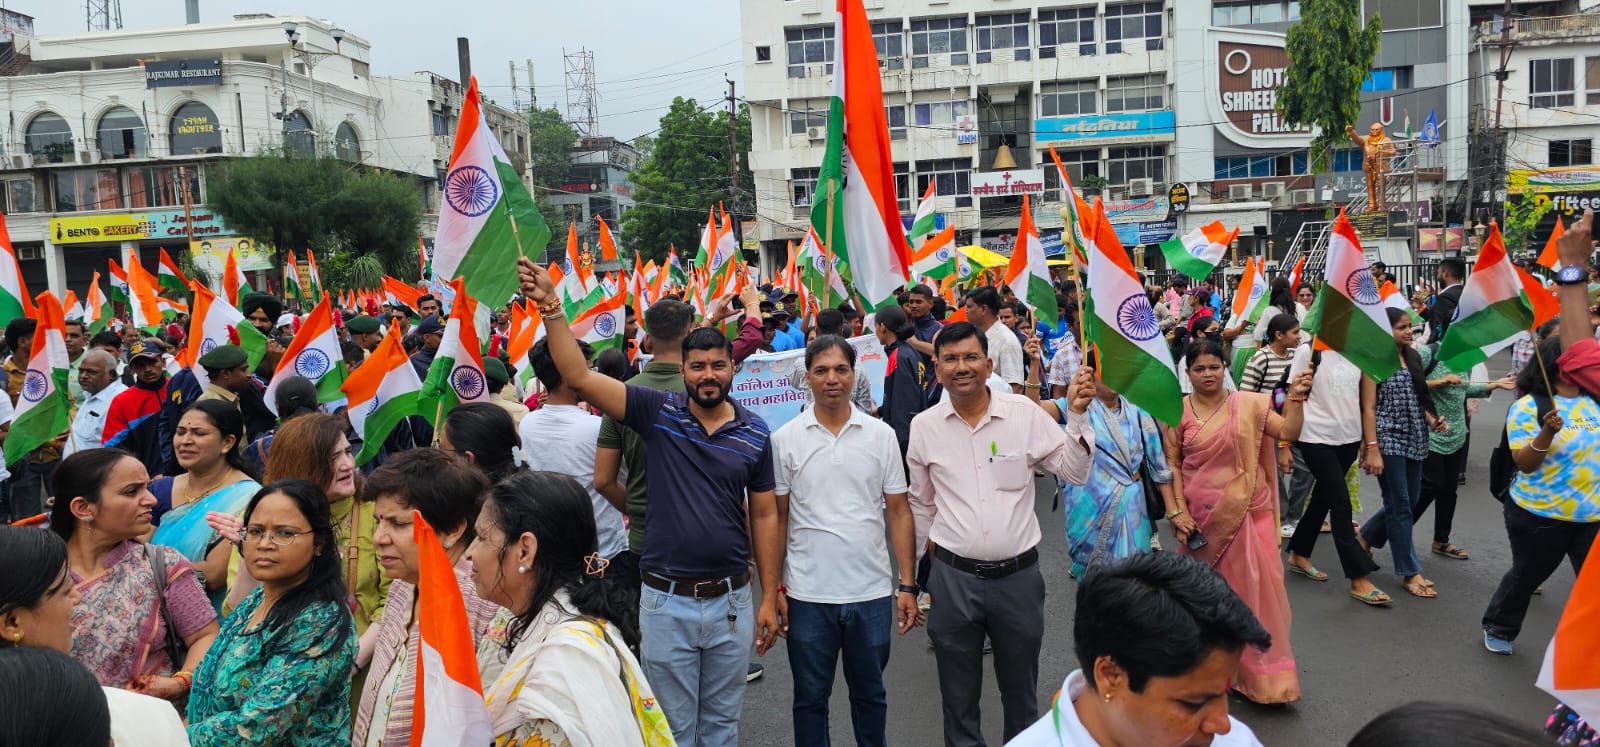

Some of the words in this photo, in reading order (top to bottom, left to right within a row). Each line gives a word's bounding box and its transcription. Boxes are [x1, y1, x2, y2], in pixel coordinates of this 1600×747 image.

[146, 70, 180, 80] RAJKUMAR
[181, 69, 221, 78] RESTAURANT
[1251, 68, 1289, 89] HOT
[171, 214, 214, 222] Janam
[67, 227, 100, 237] BENTO
[167, 225, 220, 235] Cafteria
[737, 376, 773, 392] कॉलेज
[776, 374, 791, 387] ऑ
[762, 389, 805, 405] महाविद्य
